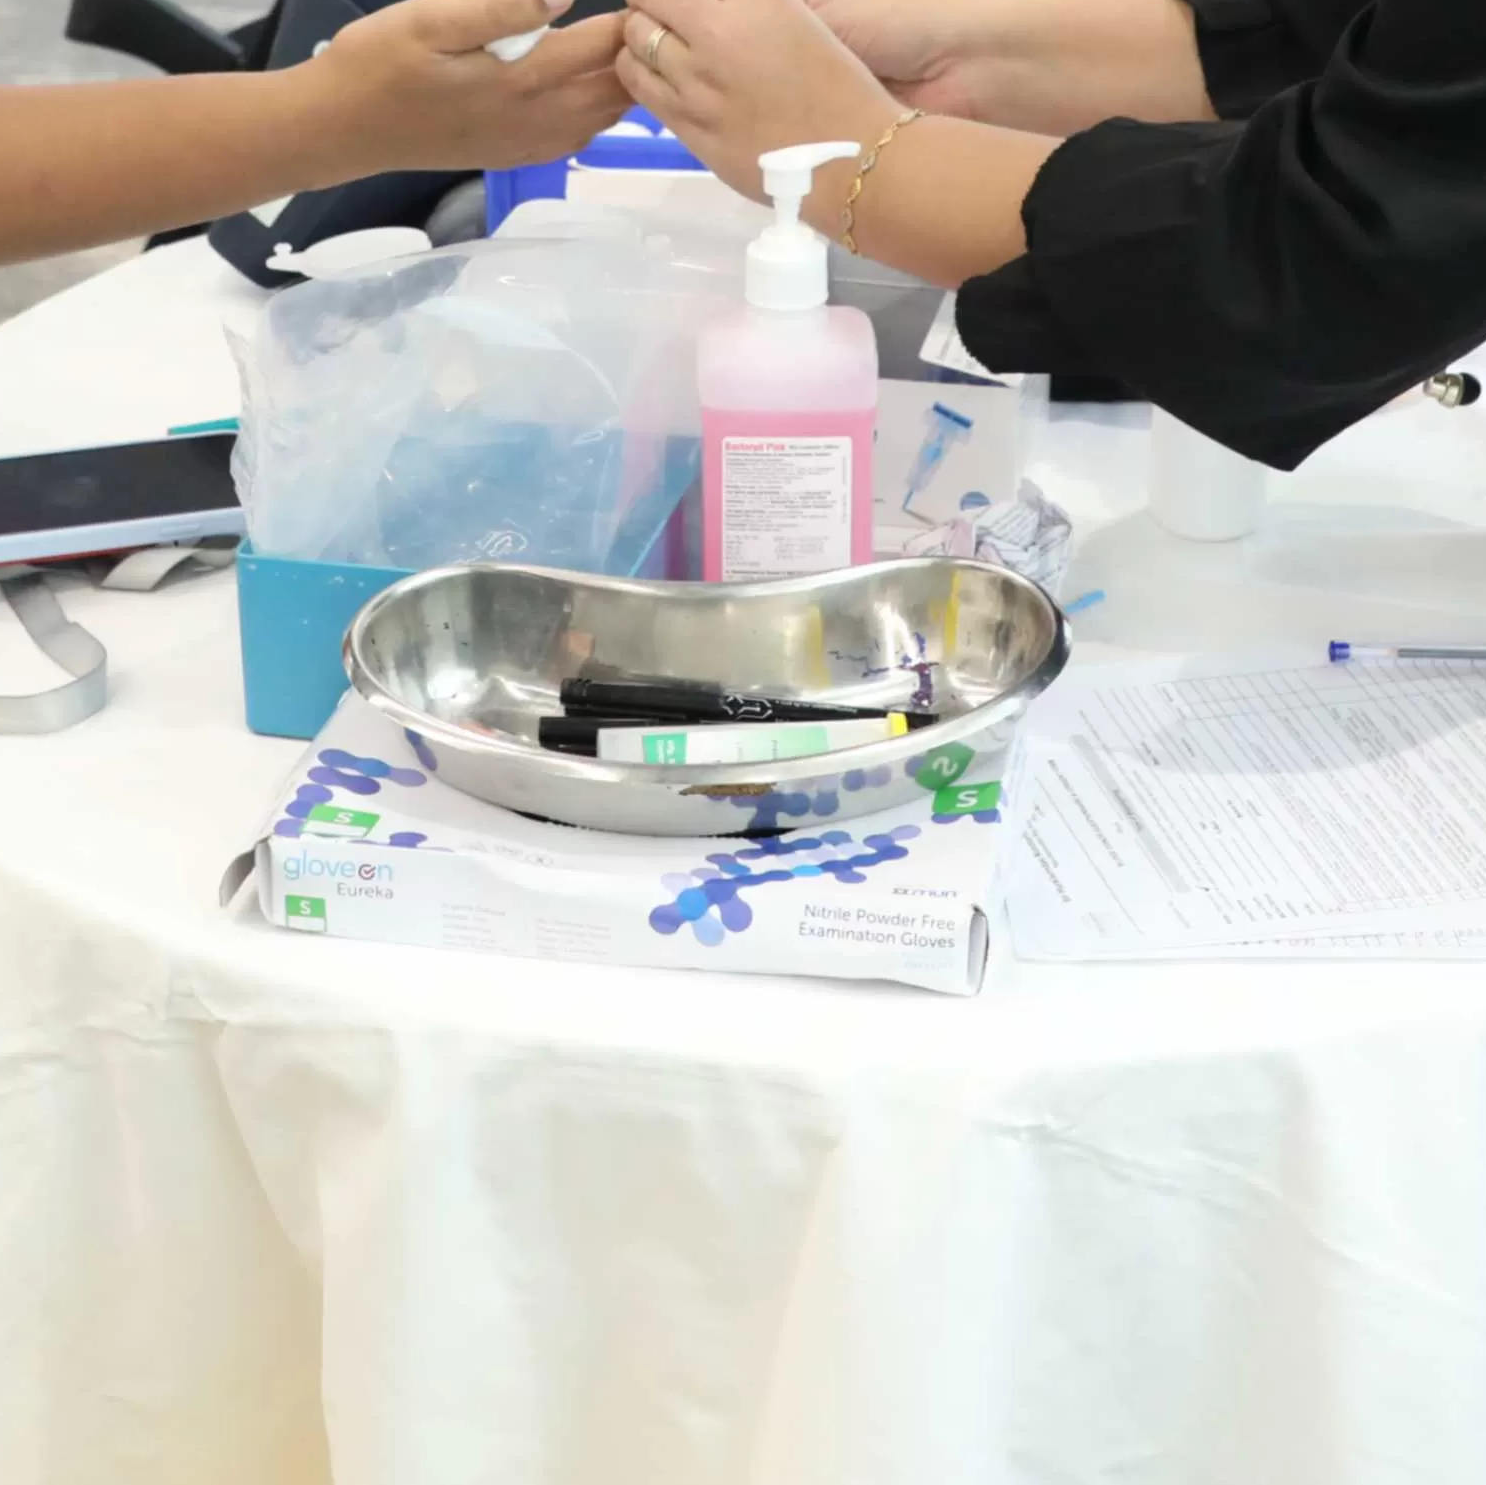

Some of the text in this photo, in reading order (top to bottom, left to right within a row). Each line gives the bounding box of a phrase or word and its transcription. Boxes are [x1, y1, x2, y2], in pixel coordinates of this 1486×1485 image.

[955, 790, 978, 807] S
[332, 811, 354, 825] S
[336, 882, 395, 901] Eureka
[298, 900, 312, 915] S
[804, 903, 956, 931] Nitrile Powder Free
[799, 921, 955, 948] Examination Gloves
